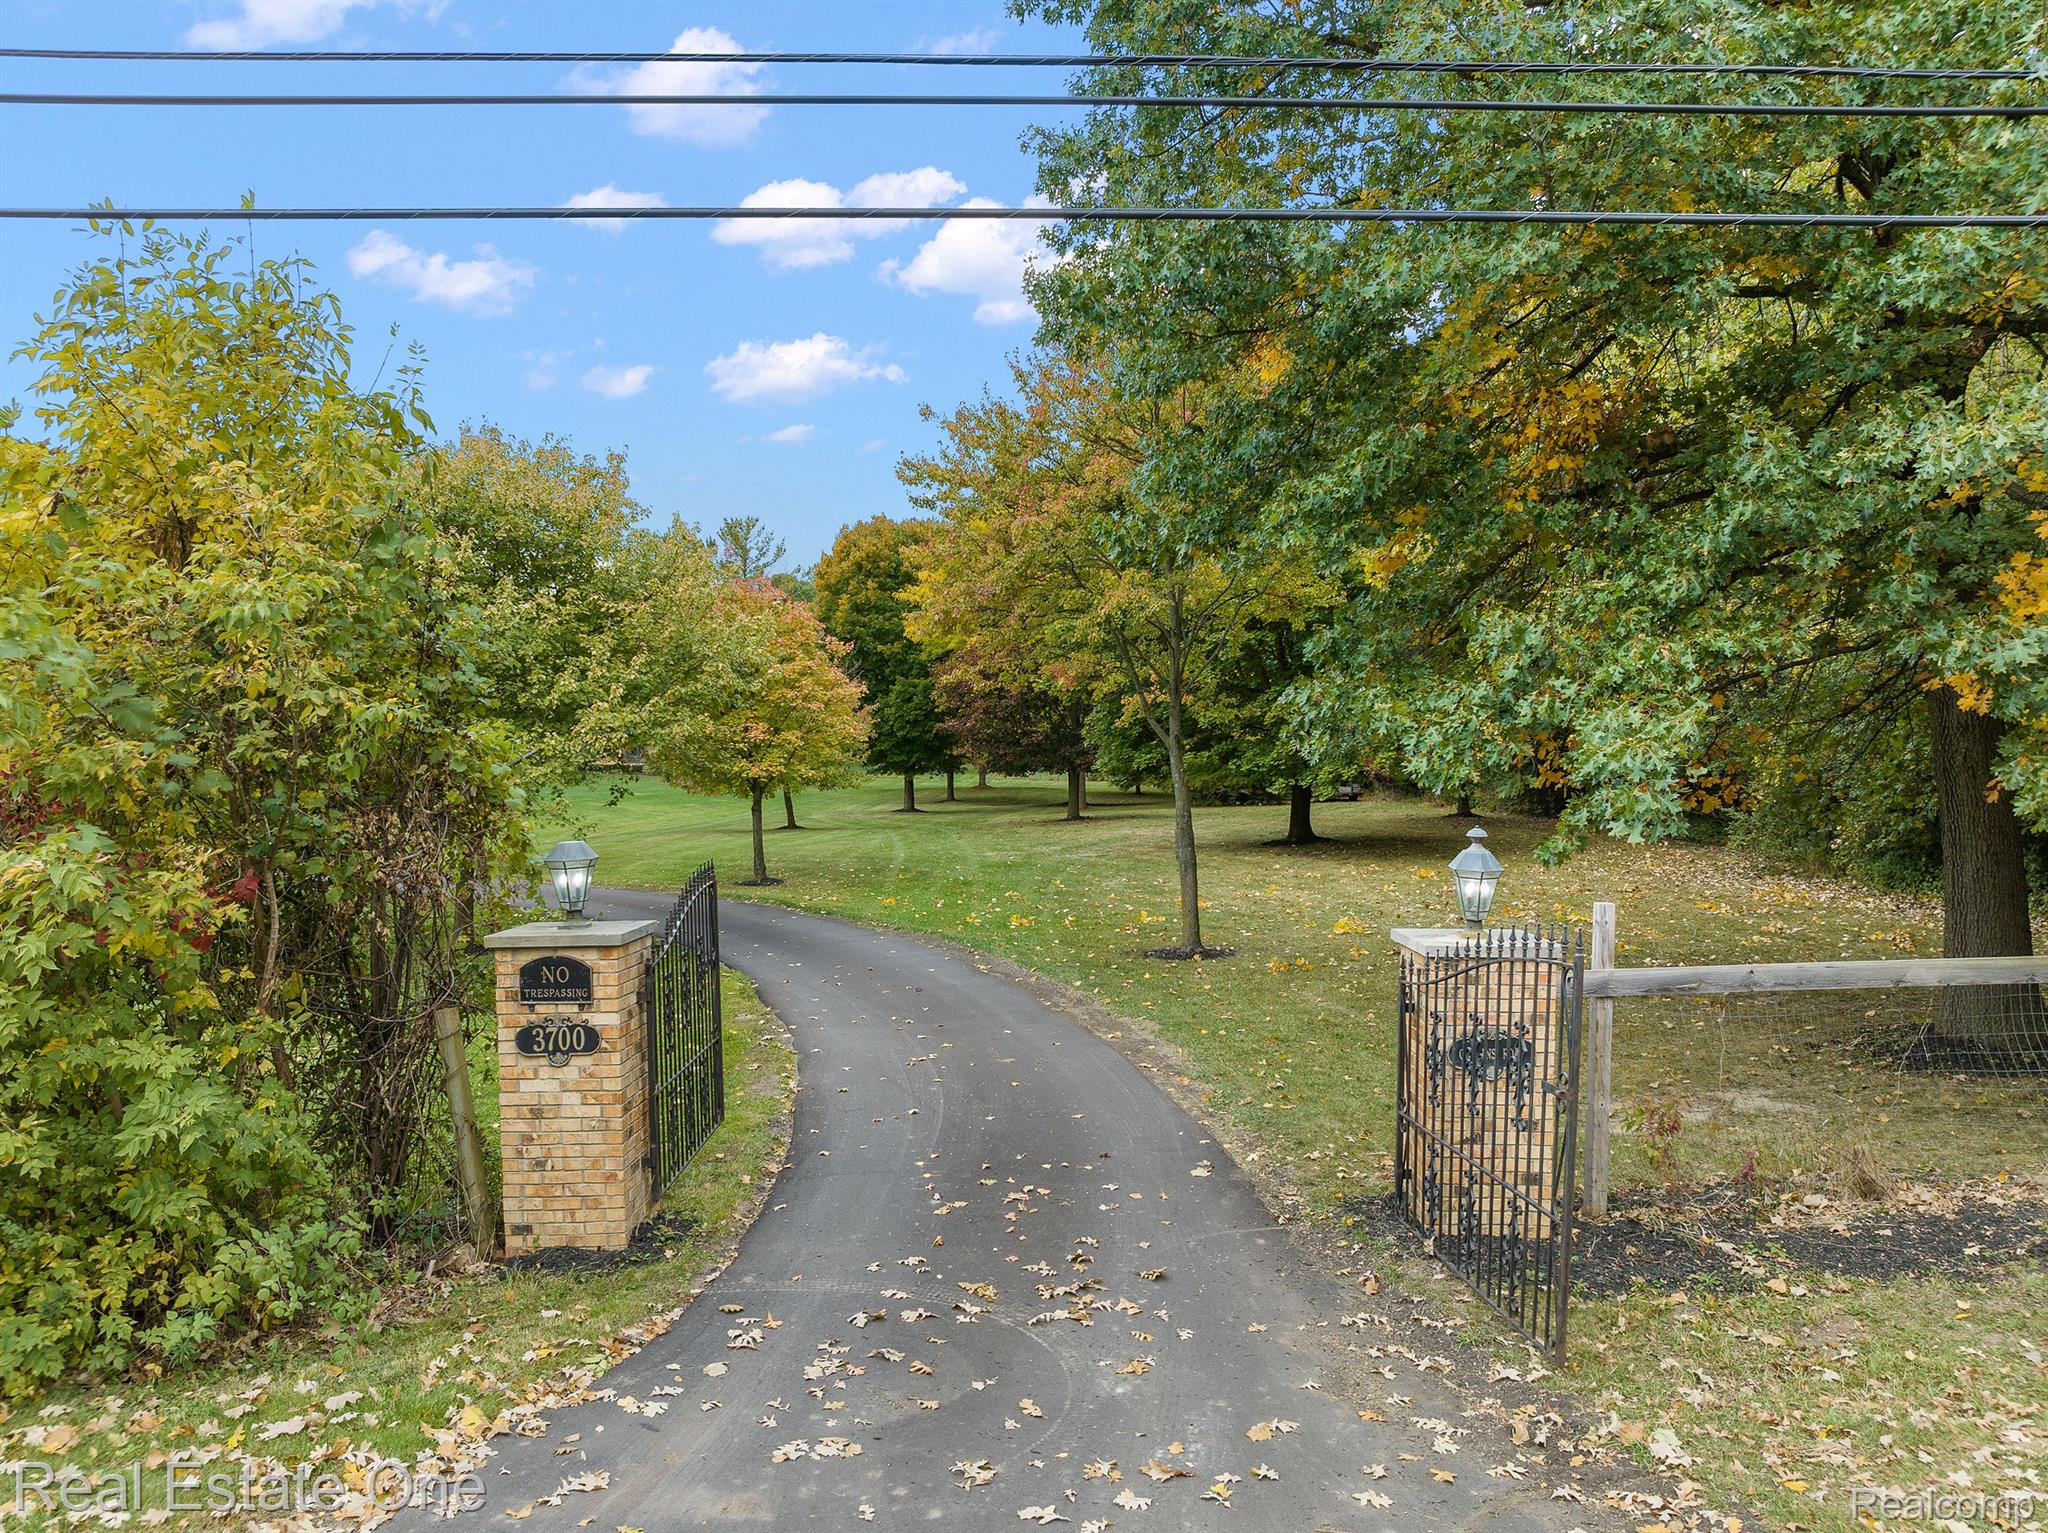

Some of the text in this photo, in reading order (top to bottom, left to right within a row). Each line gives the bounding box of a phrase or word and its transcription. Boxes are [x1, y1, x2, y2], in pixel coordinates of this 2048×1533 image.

[541, 965, 570, 984] NO
[524, 988, 589, 998] TRESPASSING
[532, 1026, 586, 1052] 3700
